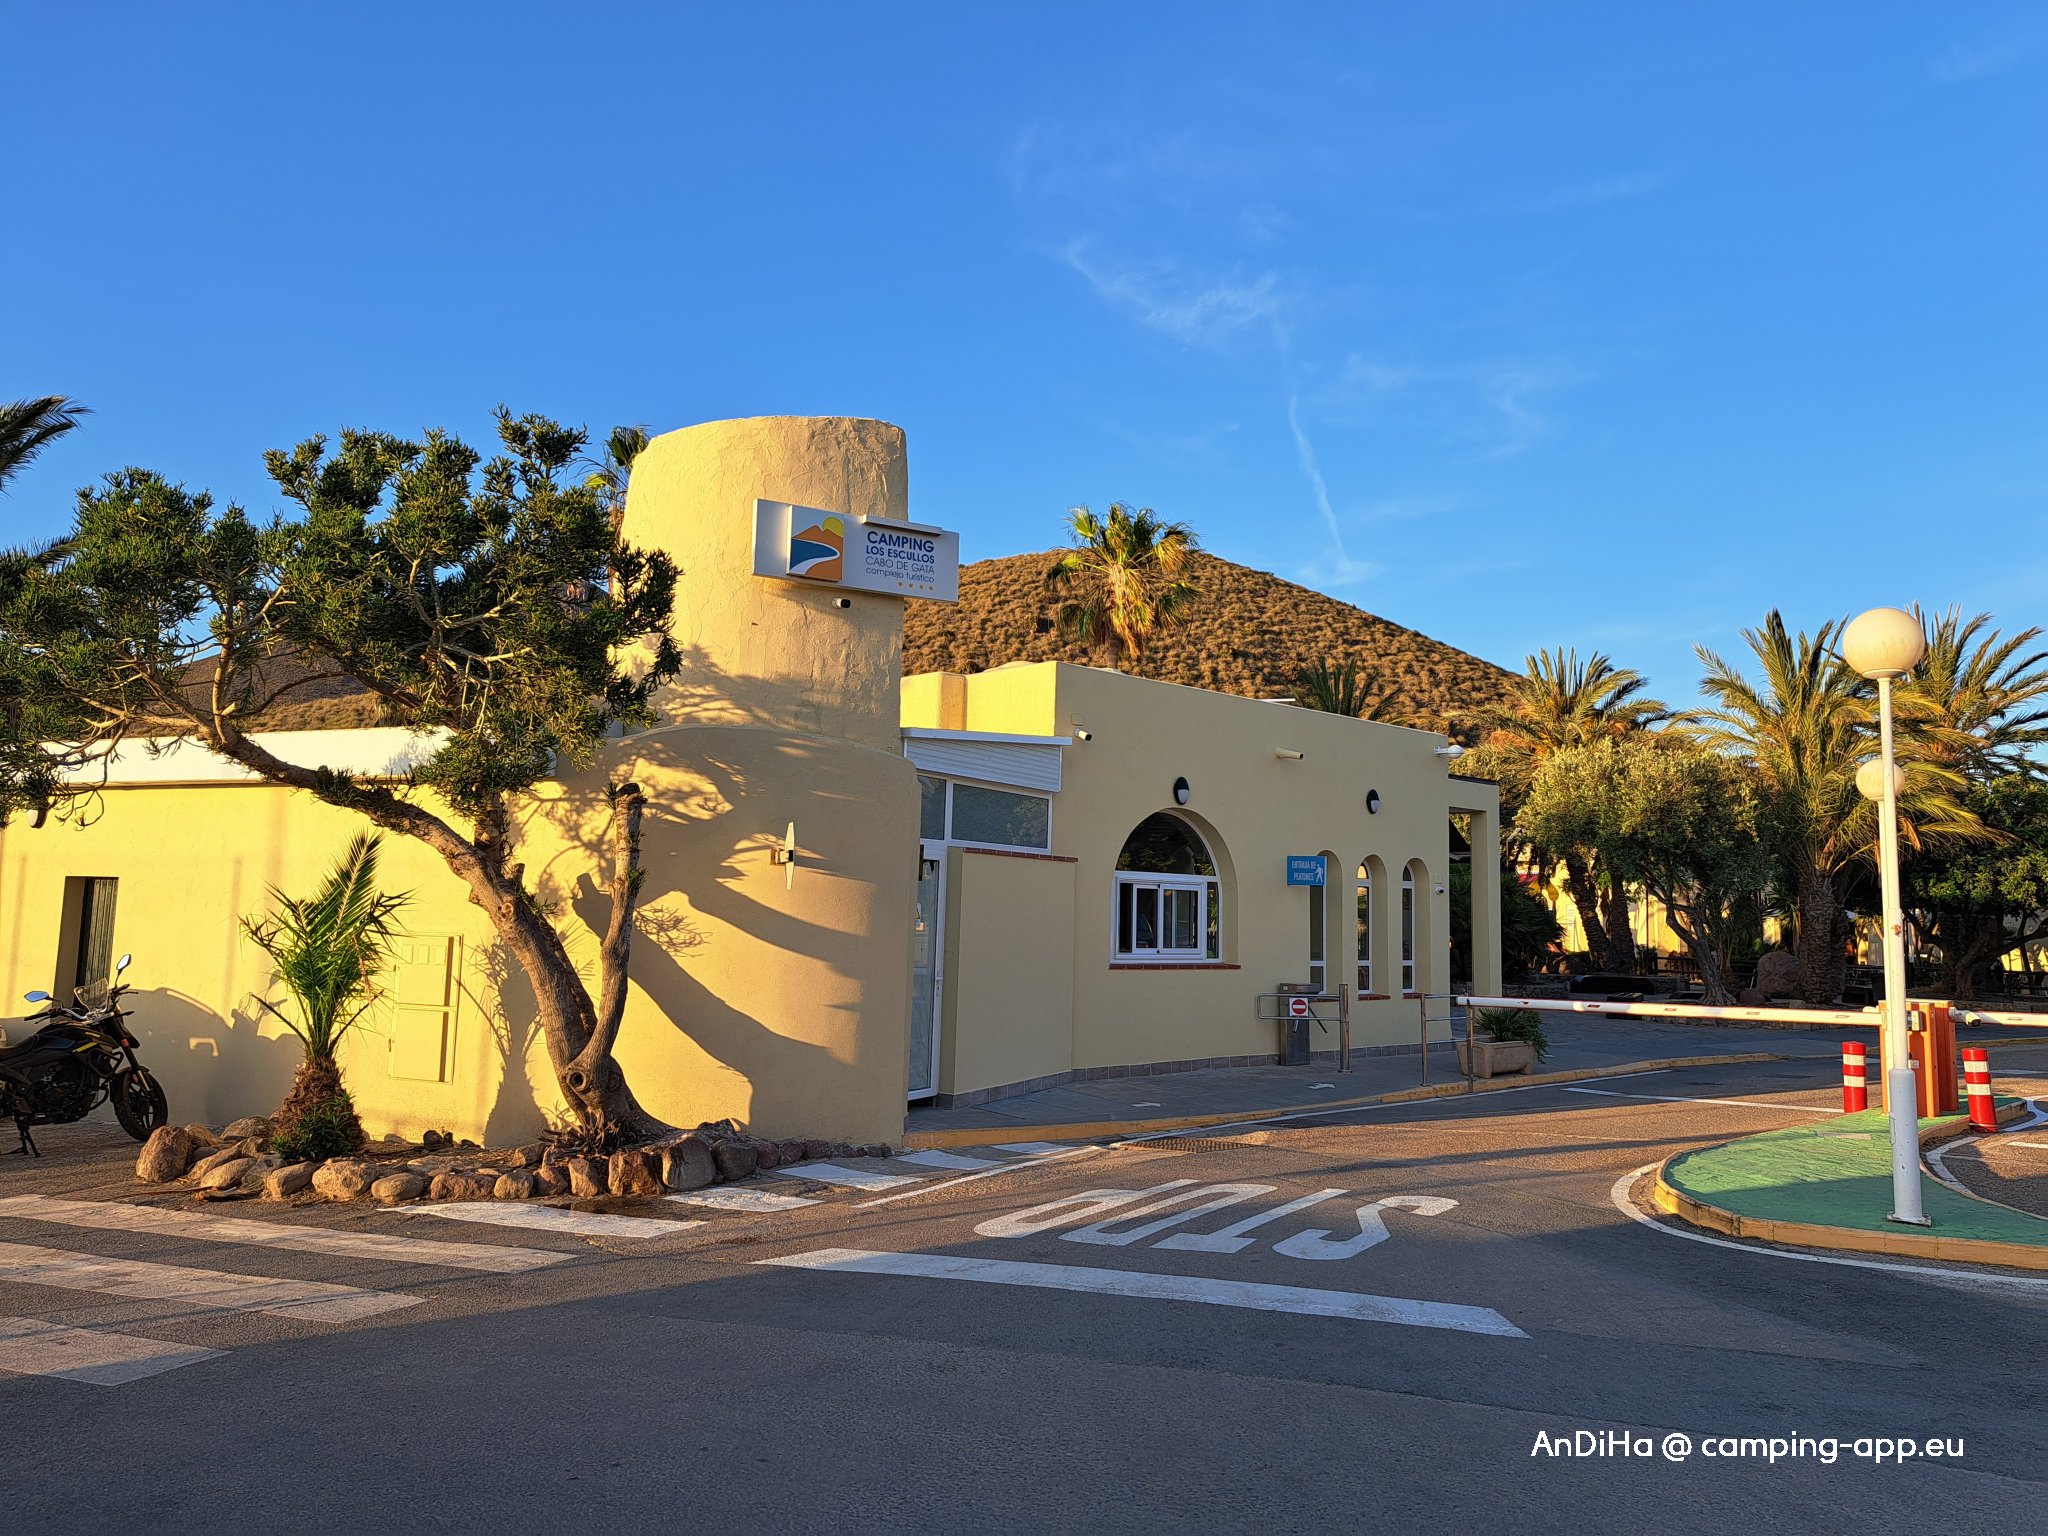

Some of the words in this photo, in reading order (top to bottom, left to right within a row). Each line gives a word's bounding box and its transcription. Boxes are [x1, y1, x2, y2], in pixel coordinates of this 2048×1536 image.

[867, 530, 935, 553] CAMPING
[866, 544, 885, 556] LOS
[888, 547, 935, 564] ESCULLOS
[865, 555, 894, 568] CABO
[896, 560, 909, 570] DE
[911, 561, 935, 574] GATA
[865, 567, 904, 579] complejo
[1291, 860, 1310, 869] ENTRADA
[973, 1178, 1460, 1260] STOP
